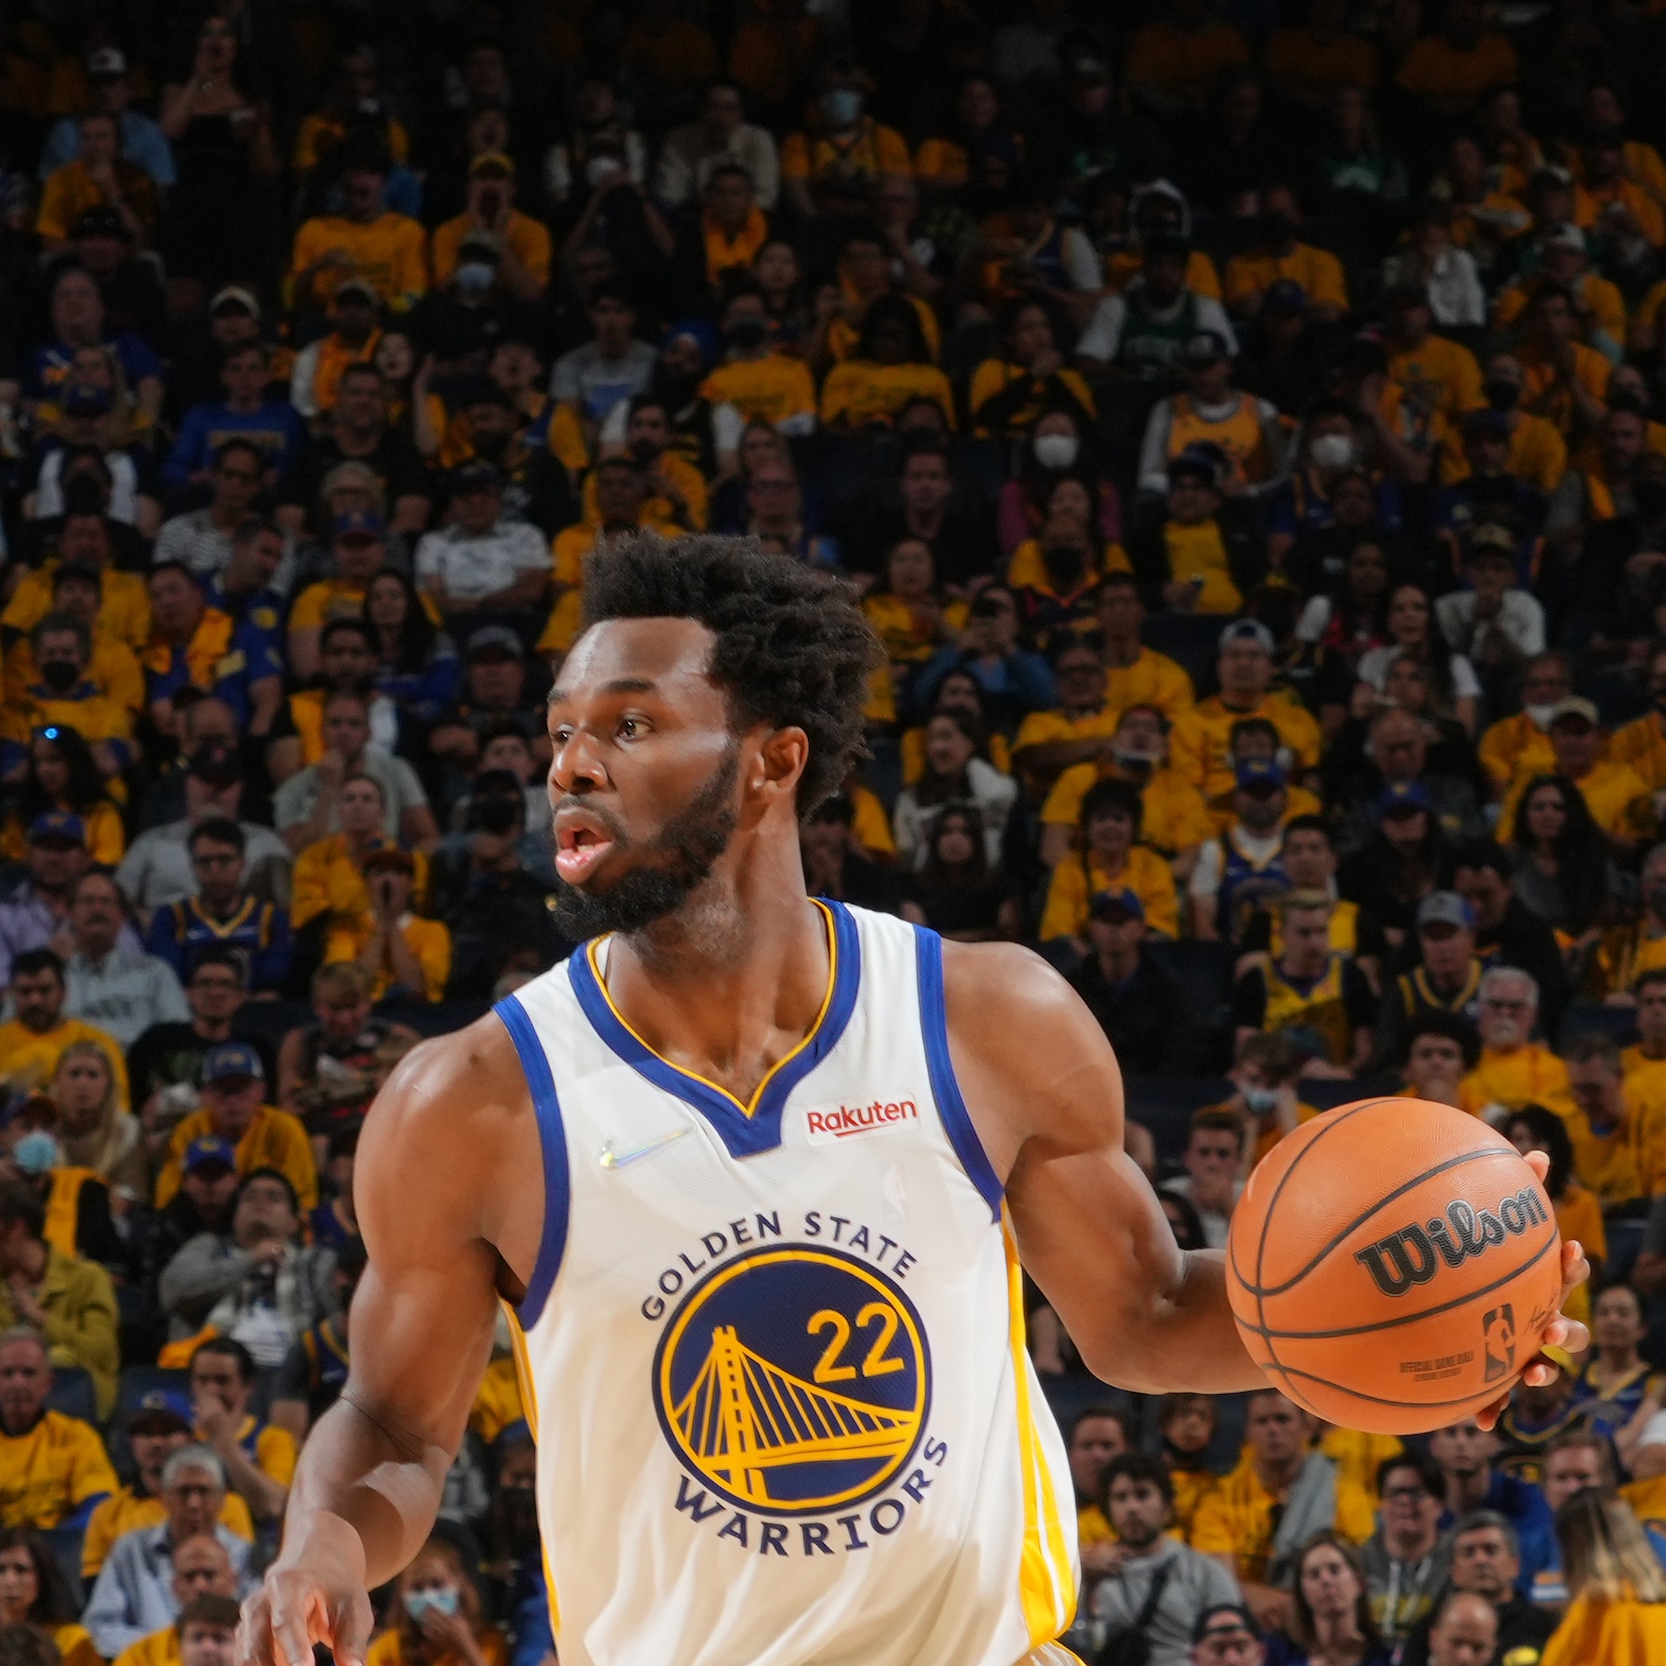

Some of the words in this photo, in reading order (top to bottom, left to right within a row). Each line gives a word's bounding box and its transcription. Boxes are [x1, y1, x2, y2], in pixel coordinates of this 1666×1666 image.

[807, 1099, 918, 1136] Rakuten
[641, 1211, 782, 1322] GOLDEN
[805, 1212, 917, 1280] STATE
[1354, 1186, 1548, 1297] Wilson
[806, 1302, 905, 1384] 22
[674, 1436, 949, 1557] WARRIORS
